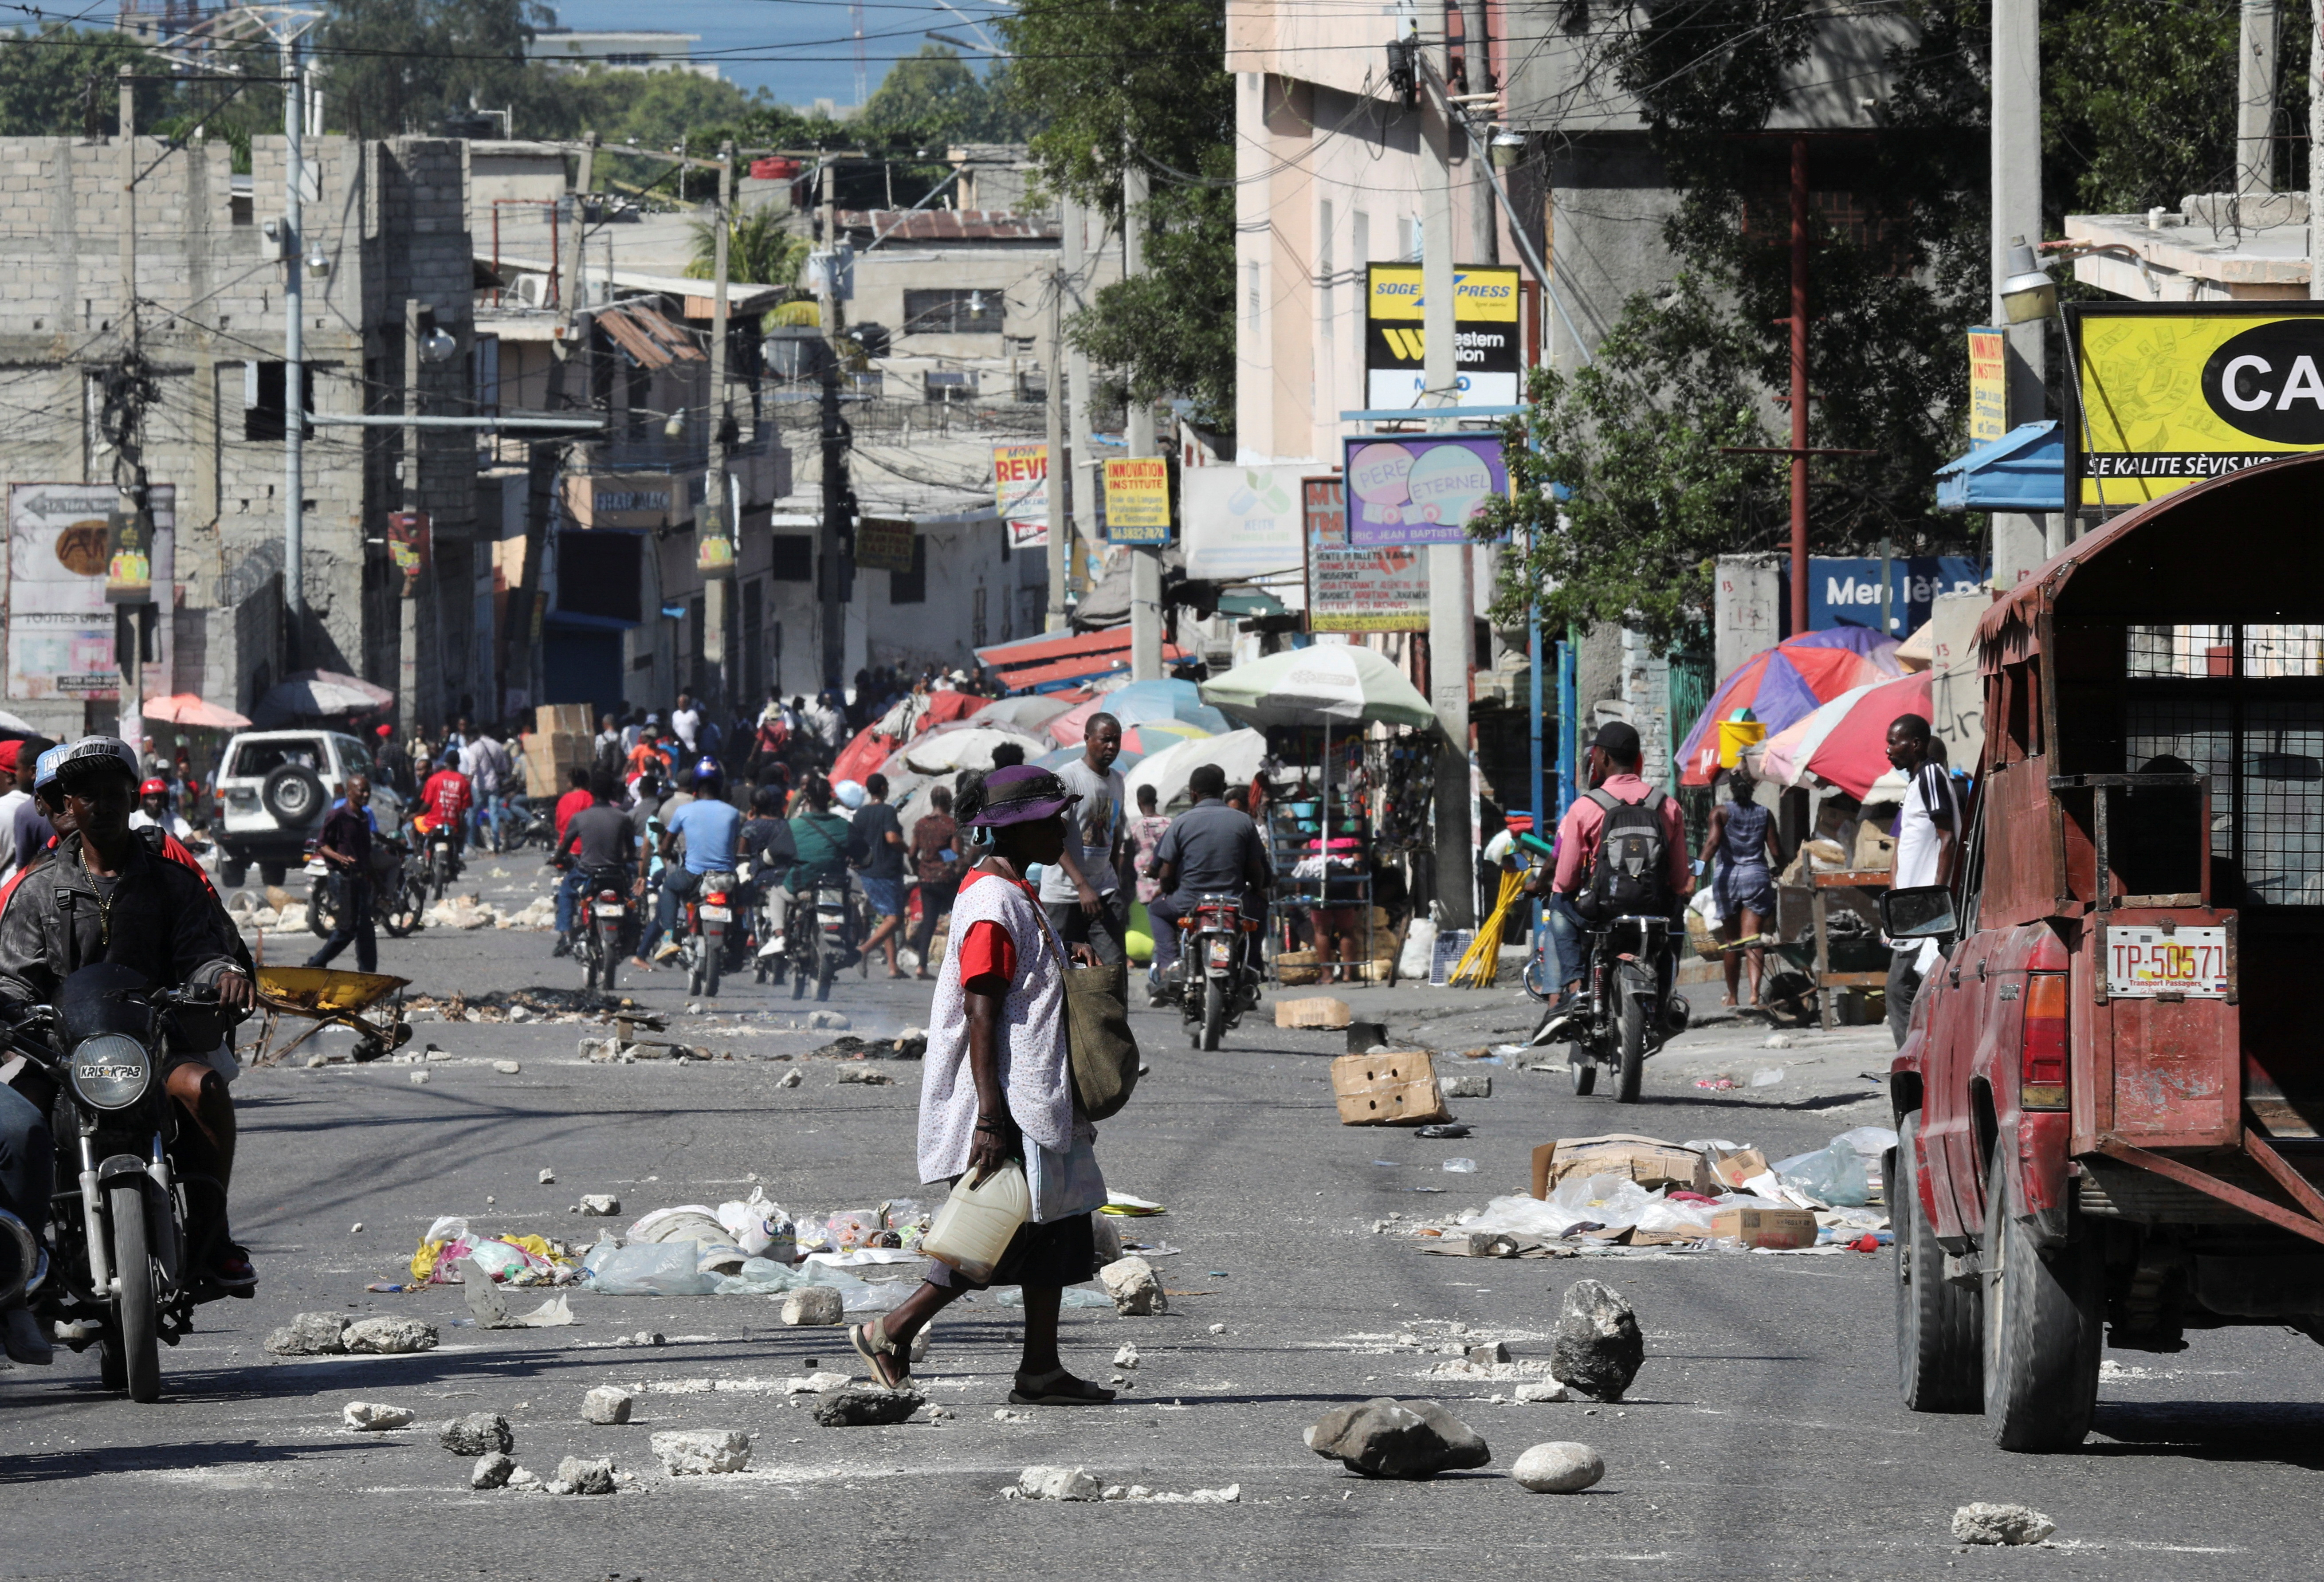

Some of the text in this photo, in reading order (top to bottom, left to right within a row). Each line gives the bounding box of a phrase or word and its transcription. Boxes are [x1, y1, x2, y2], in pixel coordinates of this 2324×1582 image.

[1454, 332, 1504, 347] estern
[1456, 347, 1484, 362] ion
[1108, 463, 1164, 477] INNOVATION
[2087, 457, 2111, 474] SE
[2114, 457, 2182, 474] KALITE
[2184, 454, 2238, 474] SÈVIS
[1360, 459, 1408, 488] PERE
[1110, 480, 1162, 489] INSTITUTE
[1412, 474, 1489, 499] ETERNEL
[1378, 530, 1405, 540] JEAN
[1410, 529, 1459, 538] BAPTISTE
[1827, 577, 1893, 605] Men
[1936, 643, 1950, 656] 13
[2112, 945, 2227, 979] TP-50571
[81, 1066, 103, 1078] KRIS
